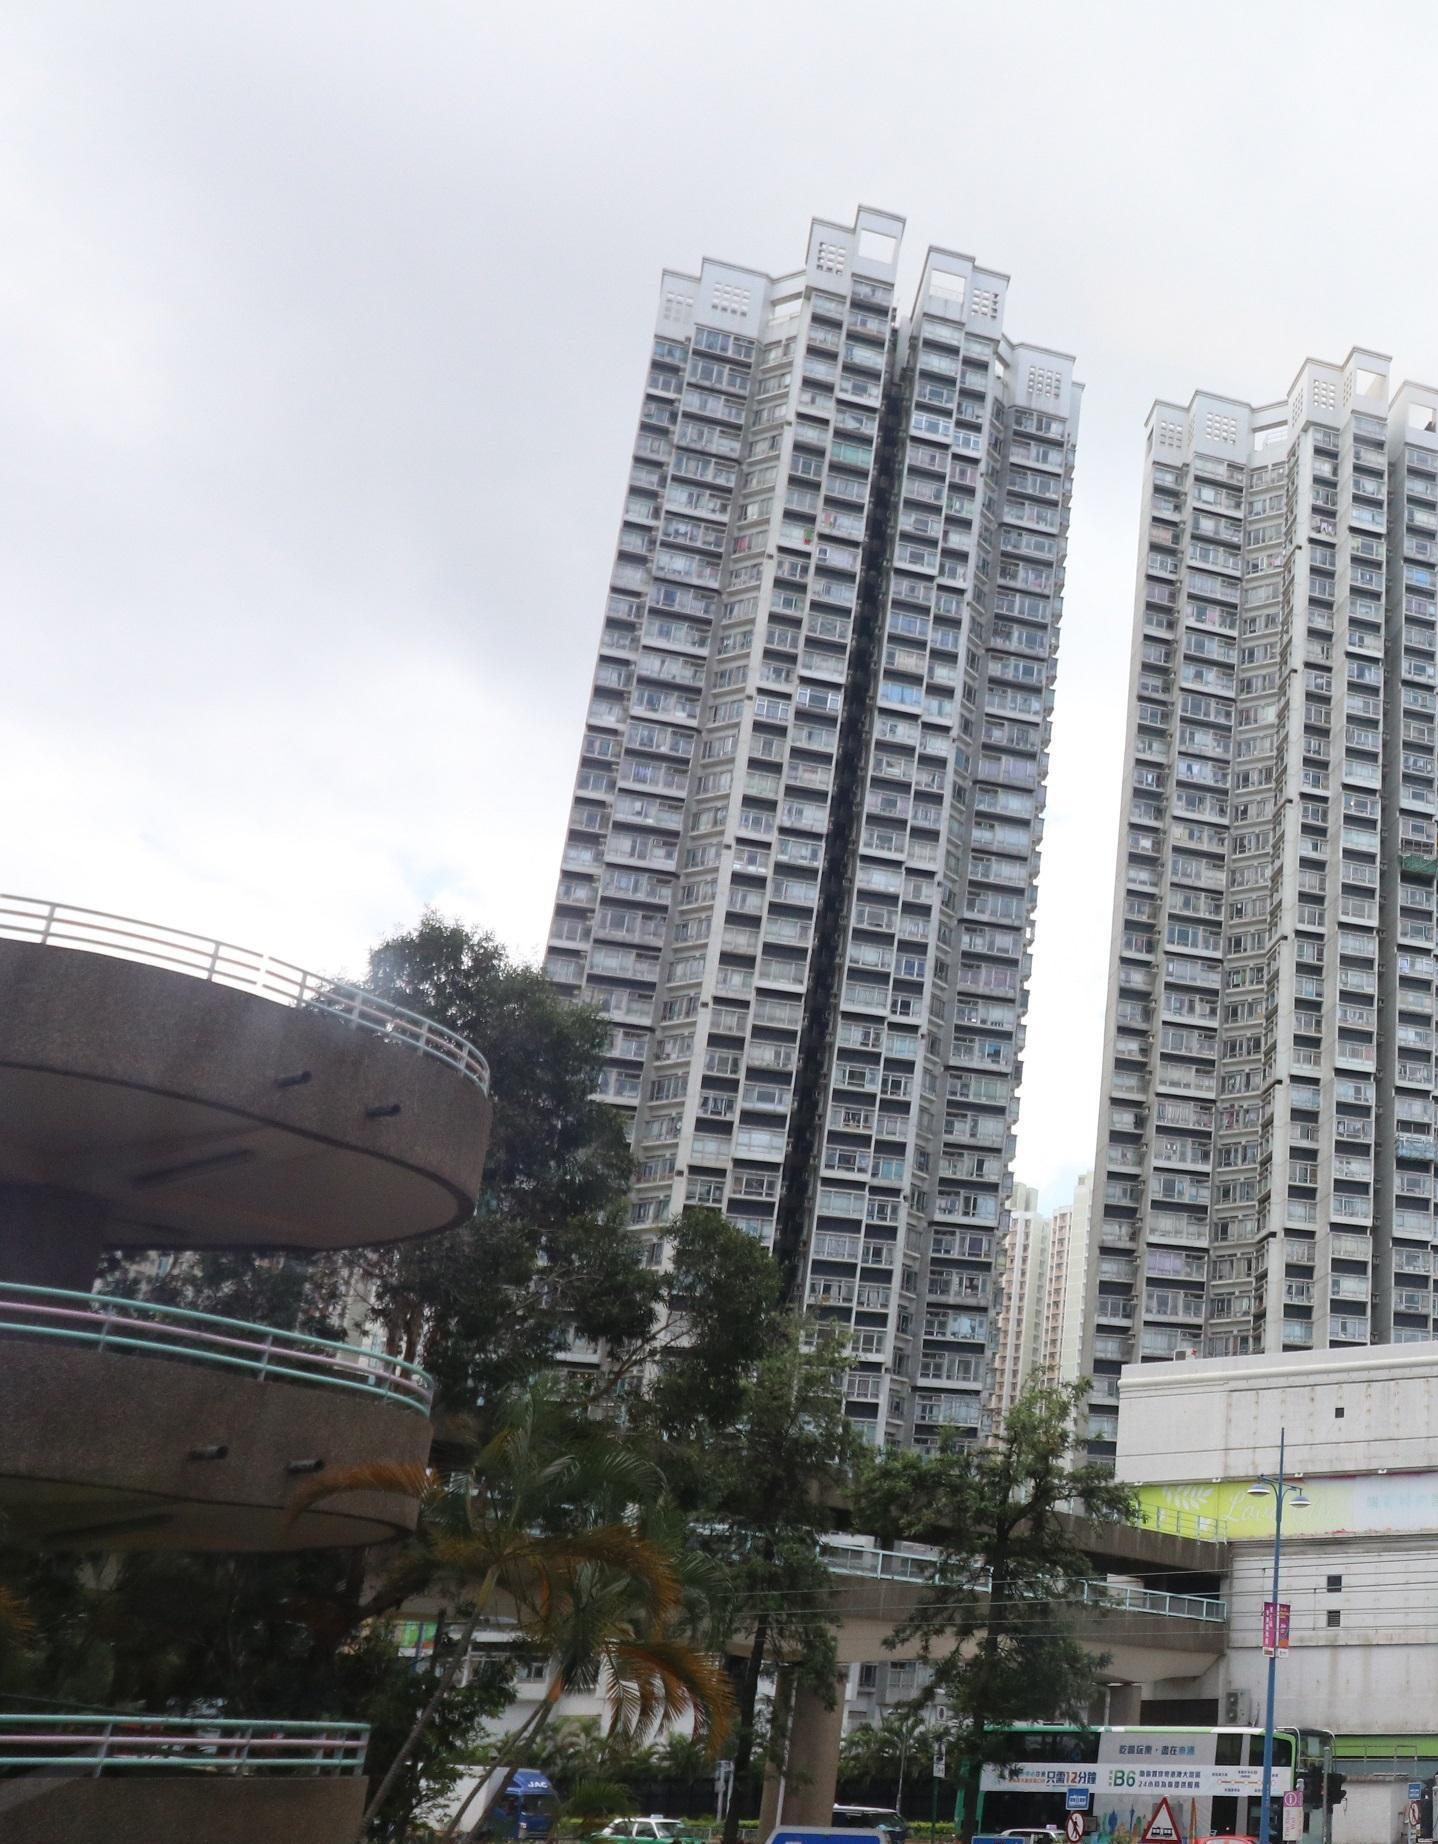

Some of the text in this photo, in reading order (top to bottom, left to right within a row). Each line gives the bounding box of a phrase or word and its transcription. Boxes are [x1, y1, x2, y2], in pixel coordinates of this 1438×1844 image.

[1046, 1771, 1096, 1784] 只需12分鐘
[1113, 1769, 1136, 1787] B6
